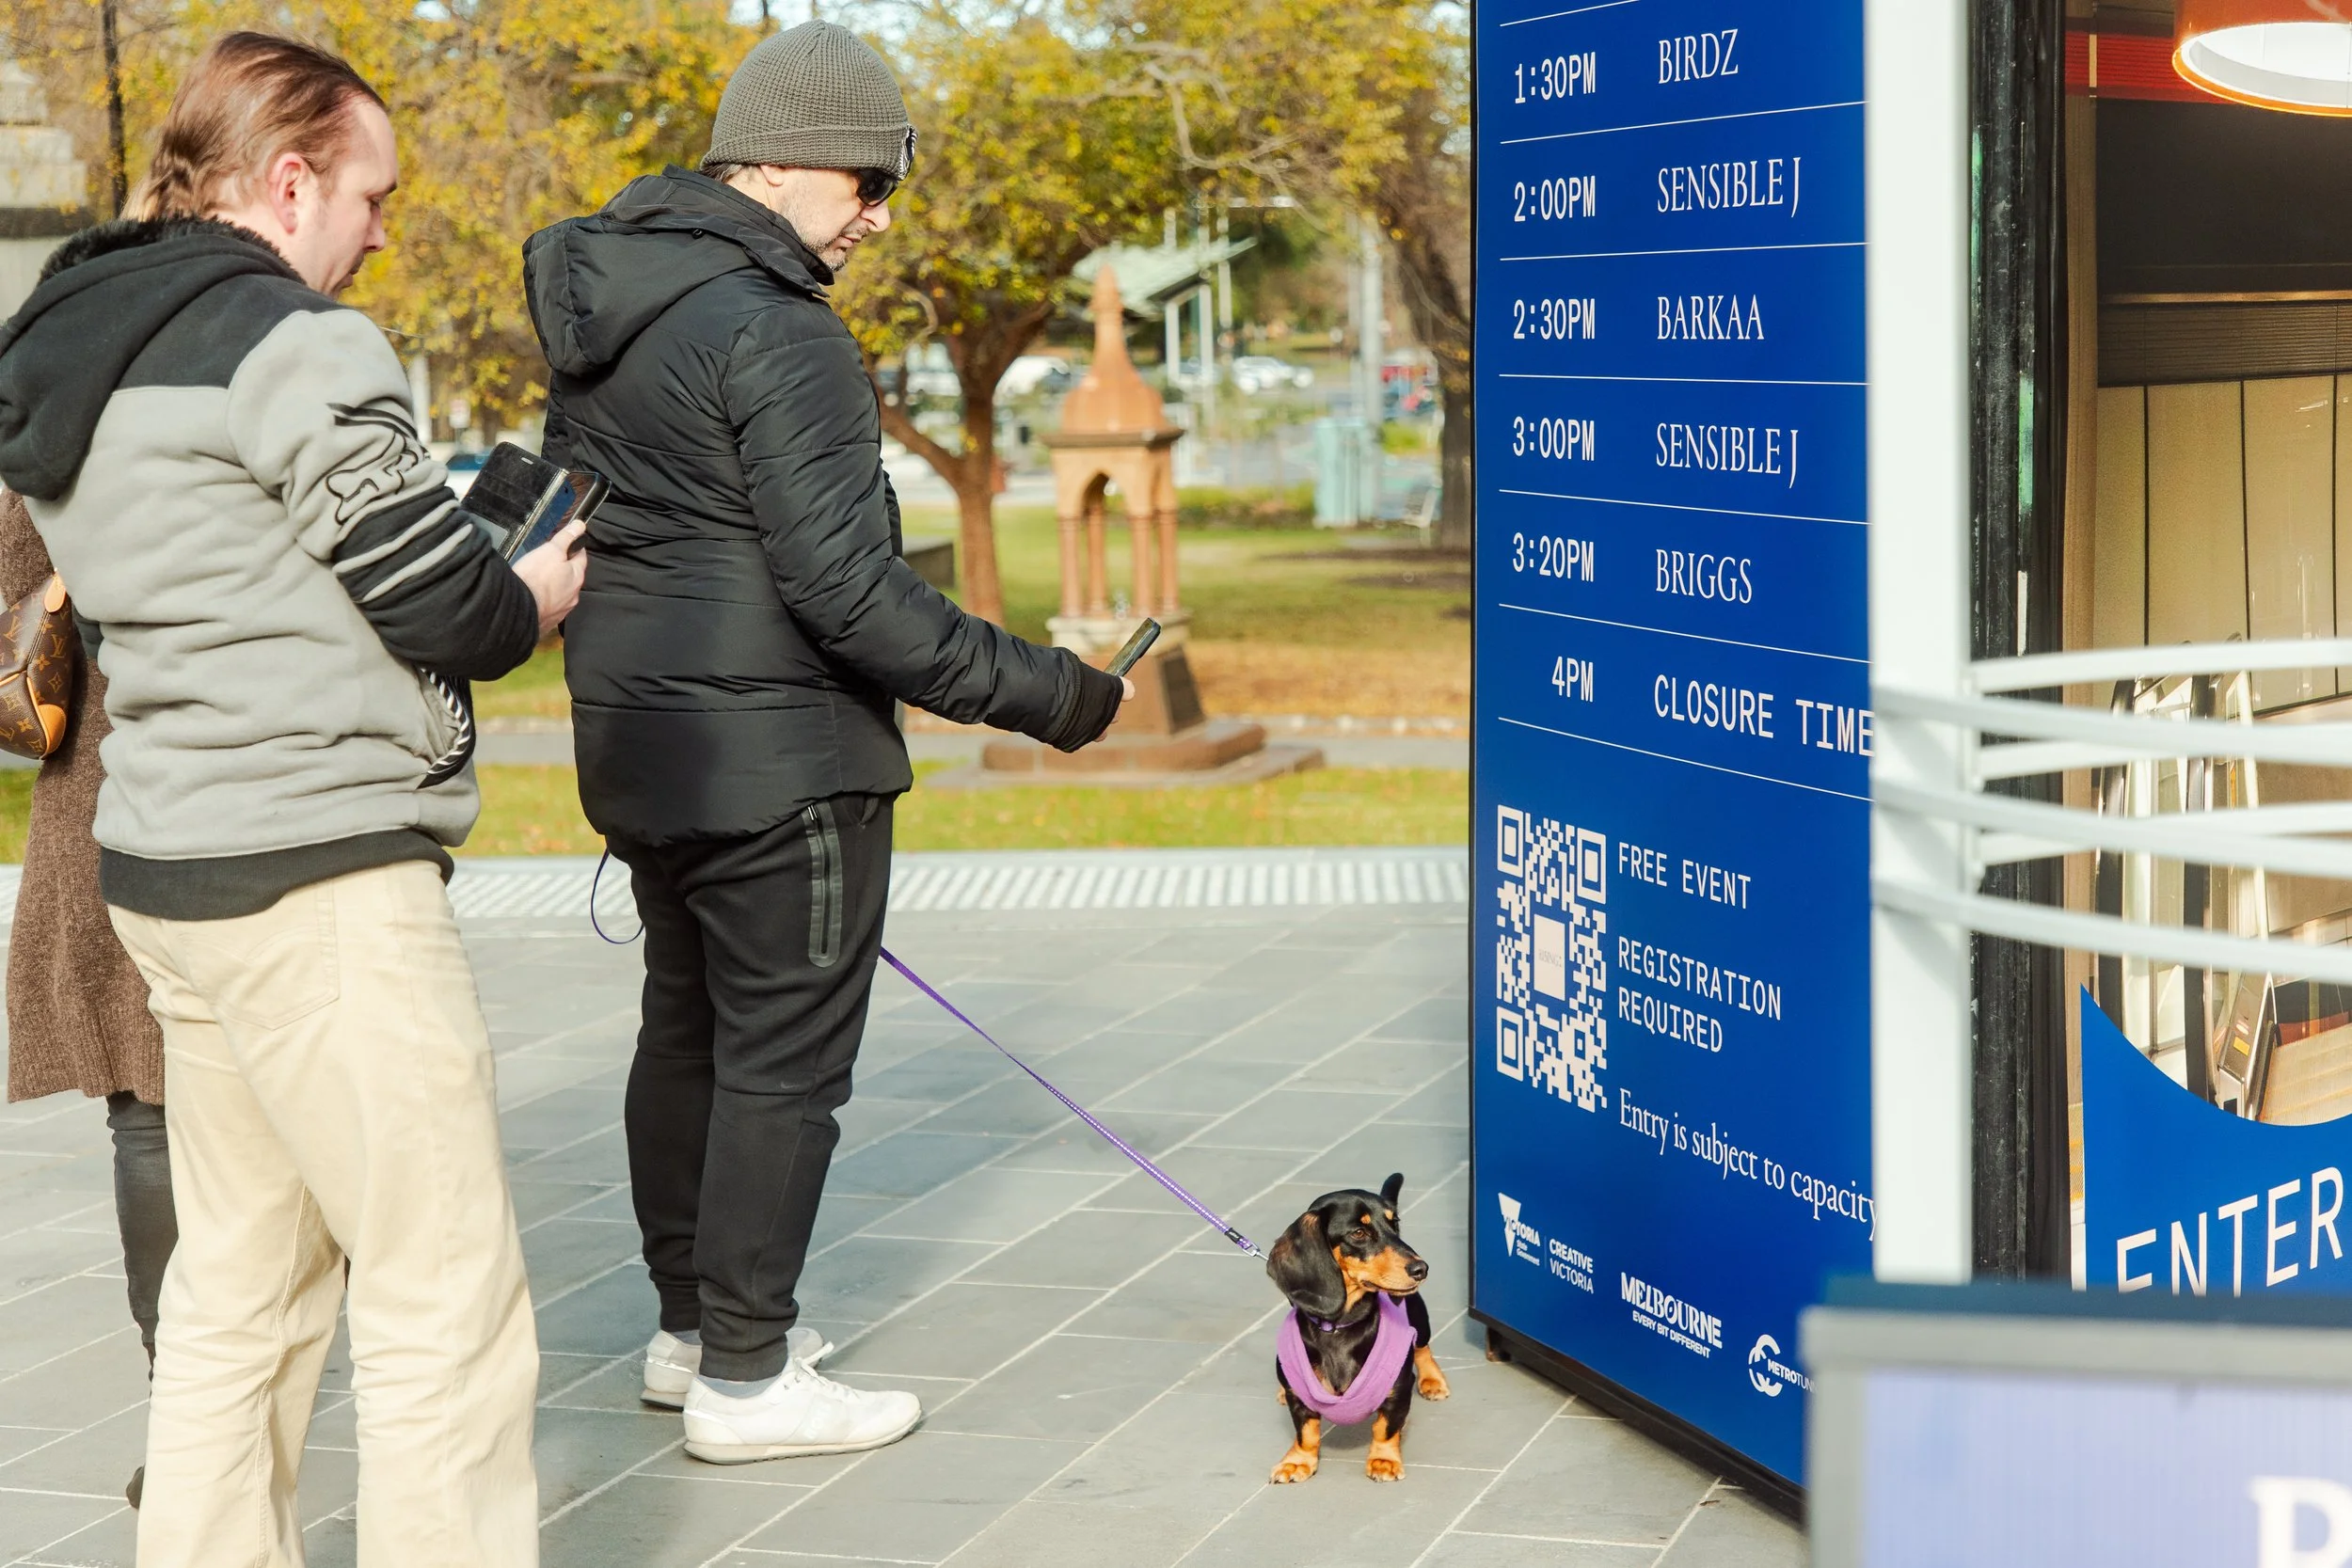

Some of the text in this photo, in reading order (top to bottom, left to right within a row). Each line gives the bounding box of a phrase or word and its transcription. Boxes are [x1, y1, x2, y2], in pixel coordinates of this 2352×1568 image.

[1515, 52, 1596, 103] 1:30PM
[1658, 29, 1739, 85] BIRDZ
[1514, 176, 1596, 222] 2:00PM
[1657, 157, 1802, 217] SENSIBLE J
[1513, 299, 1596, 340] 2:30PM
[1657, 294, 1765, 341] BARKAA
[1513, 417, 1595, 461] 3:00PM
[1656, 422, 1799, 488] SENSIBLE J
[1512, 532, 1595, 582] 3:20PM
[1656, 549, 1753, 604] BRIGGS
[1551, 657, 1594, 702] 4PM
[1654, 674, 1875, 757] CLOSURE TIME
[1618, 842, 1752, 910] FREE EVENT
[1618, 936, 1781, 1021] REGISTRATION
[1618, 987, 1723, 1053] REQUIRED
[1619, 1087, 1877, 1242] Entry is subject to capacity
[1549, 1238, 1594, 1274] CREATIVE
[2117, 1166, 2344, 1298] ENTER
[1549, 1258, 1595, 1294] VICTORIA
[1621, 1272, 1723, 1349] MELBOURNE
[1632, 1309, 1711, 1359] EVERY BIT DIFFERENT
